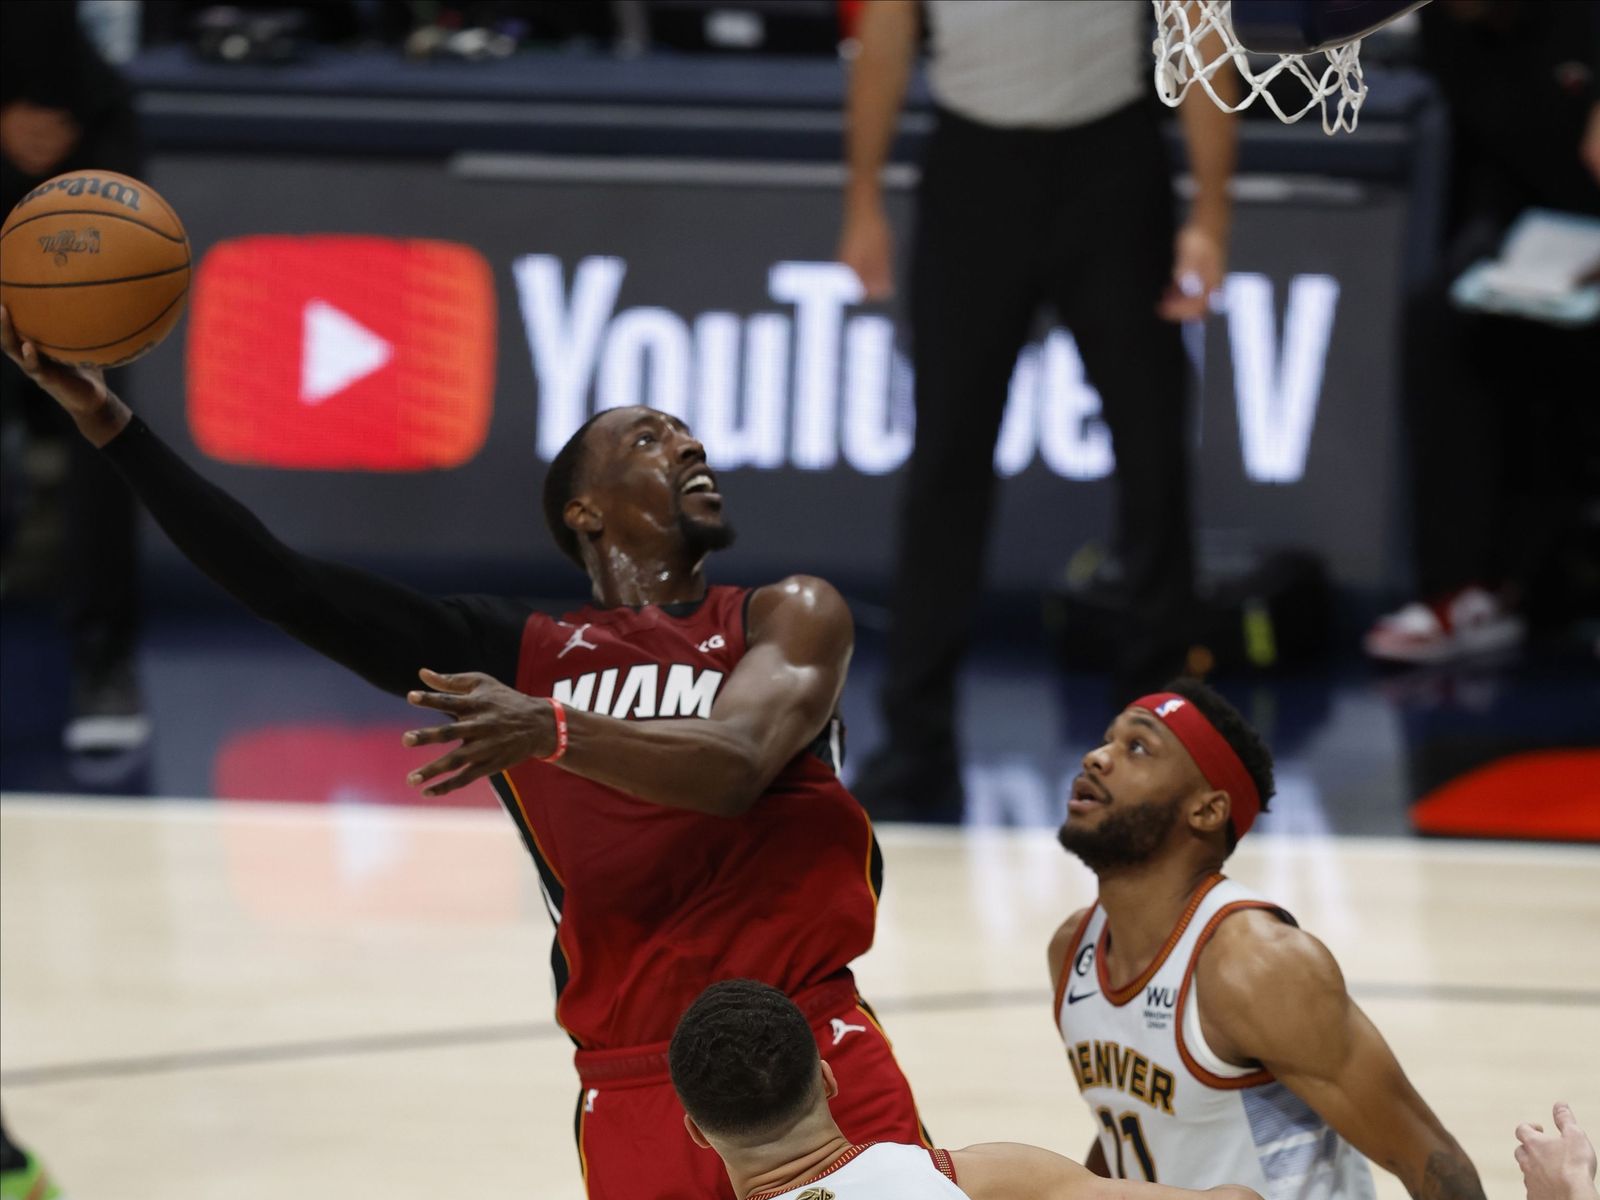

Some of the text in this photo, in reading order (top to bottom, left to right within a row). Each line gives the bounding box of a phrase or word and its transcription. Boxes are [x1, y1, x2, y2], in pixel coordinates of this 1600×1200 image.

[1178, 271, 1341, 483] V
[552, 663, 724, 720] MIAM
[1146, 986, 1177, 1008] WU
